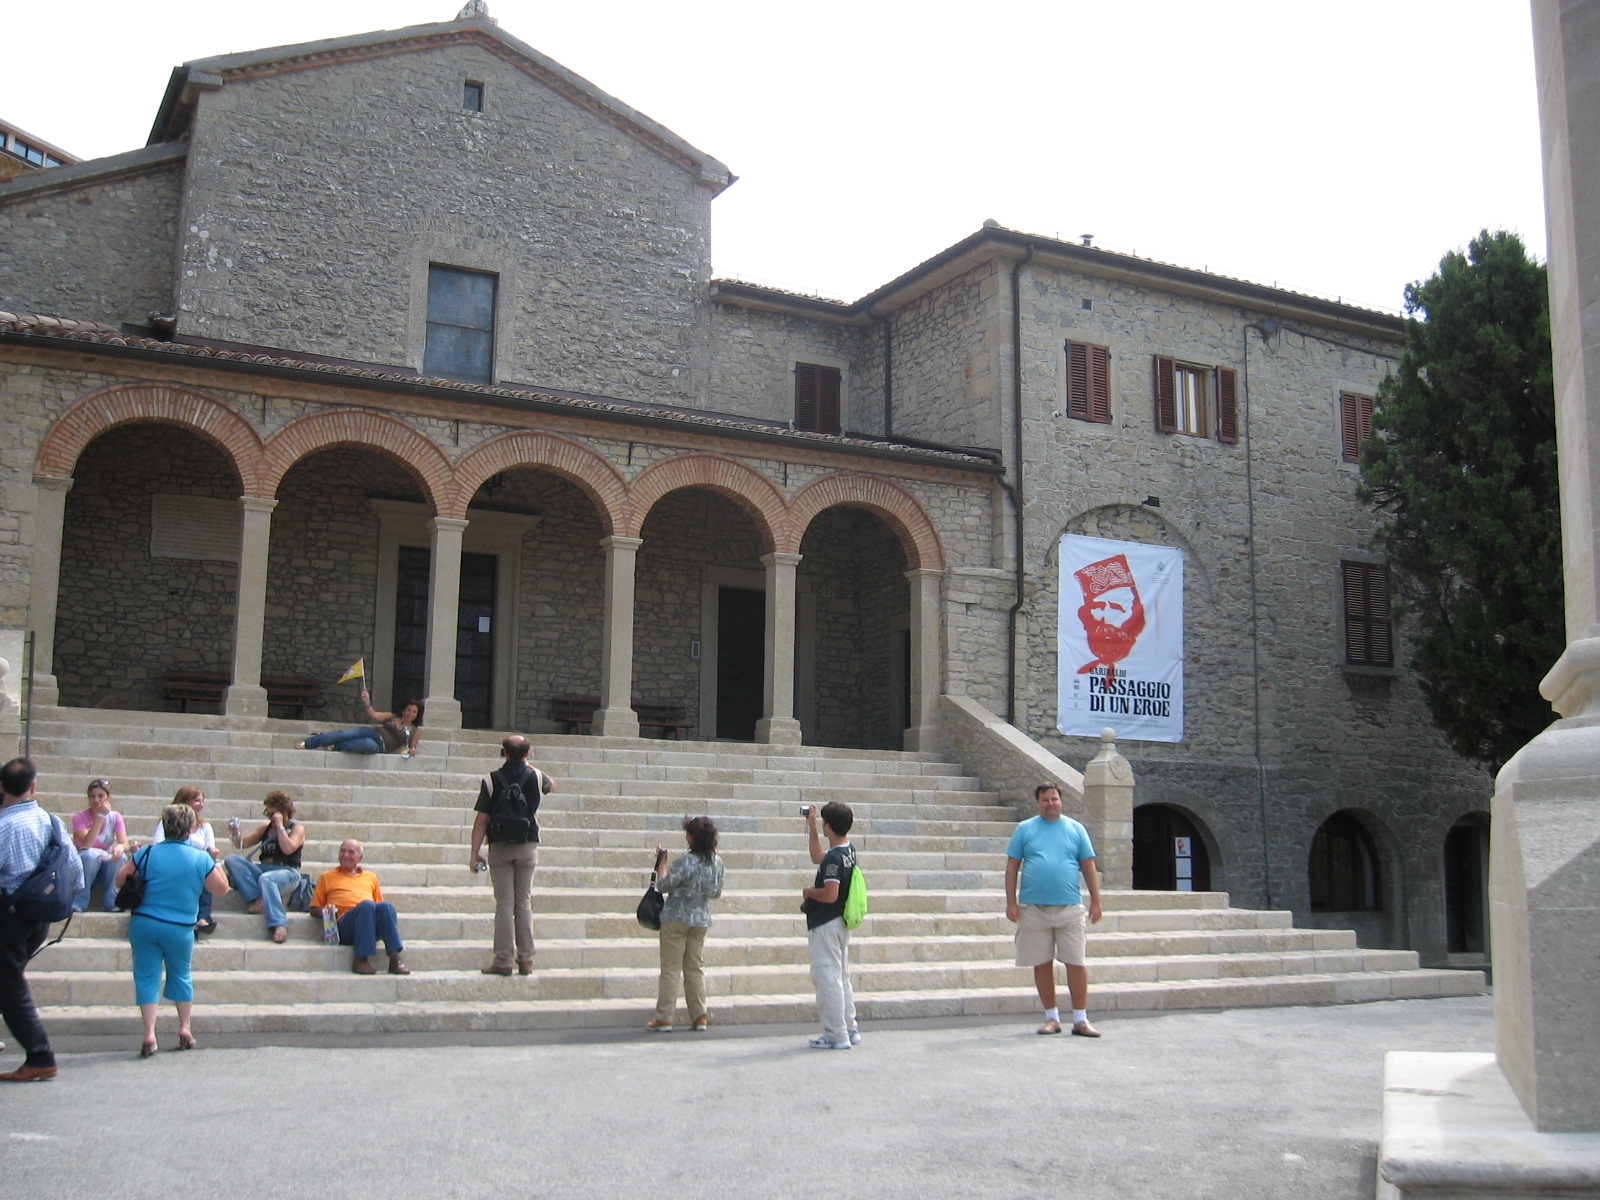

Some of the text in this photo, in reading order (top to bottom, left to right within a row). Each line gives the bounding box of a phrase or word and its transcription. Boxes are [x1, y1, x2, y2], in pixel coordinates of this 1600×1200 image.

[1089, 676, 1171, 699] PASSAGGIO
[1090, 695, 1170, 717] DI UN EROE
